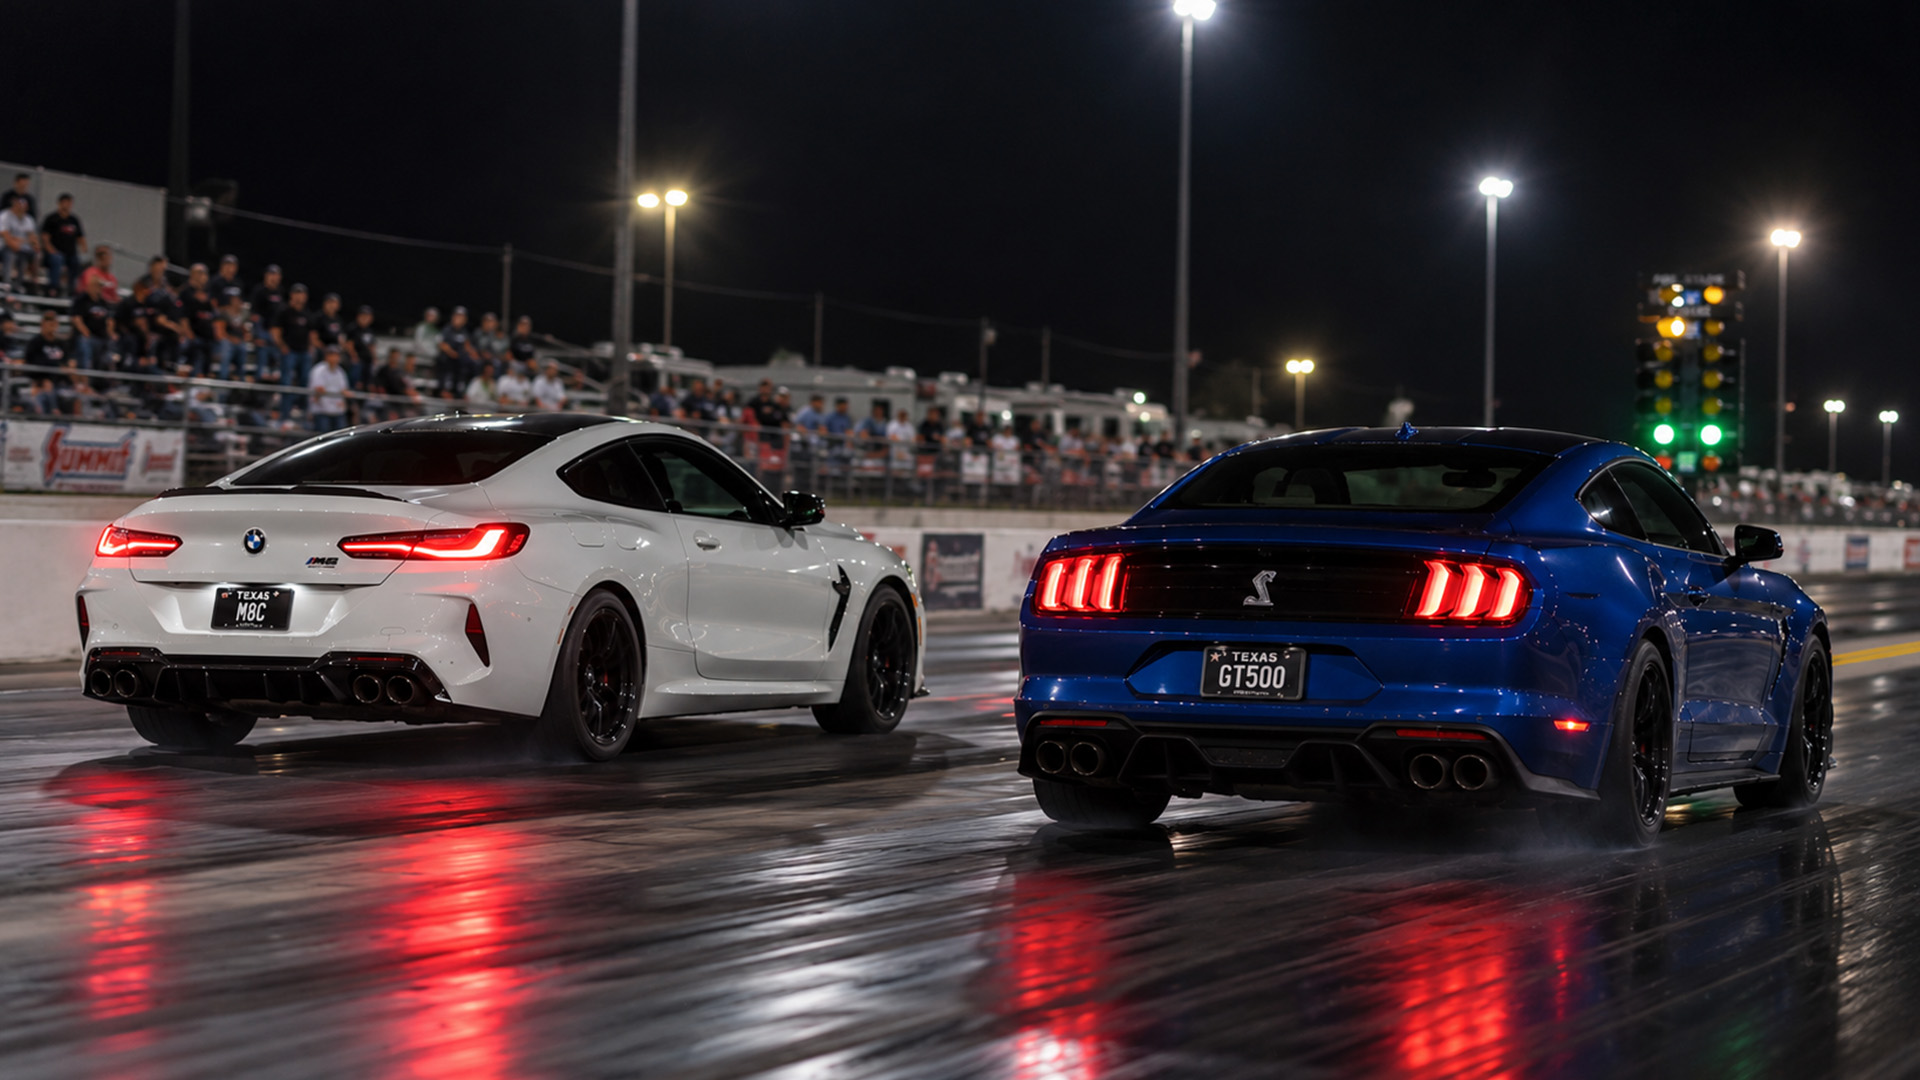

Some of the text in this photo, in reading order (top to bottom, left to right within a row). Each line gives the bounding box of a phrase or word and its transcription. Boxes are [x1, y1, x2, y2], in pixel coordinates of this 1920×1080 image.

[45, 429, 131, 481] SUMMIT
[237, 591, 270, 600] TEXAS
[236, 602, 266, 621] M8C
[1232, 651, 1278, 662] TEXAS
[1219, 664, 1286, 689] GT500
